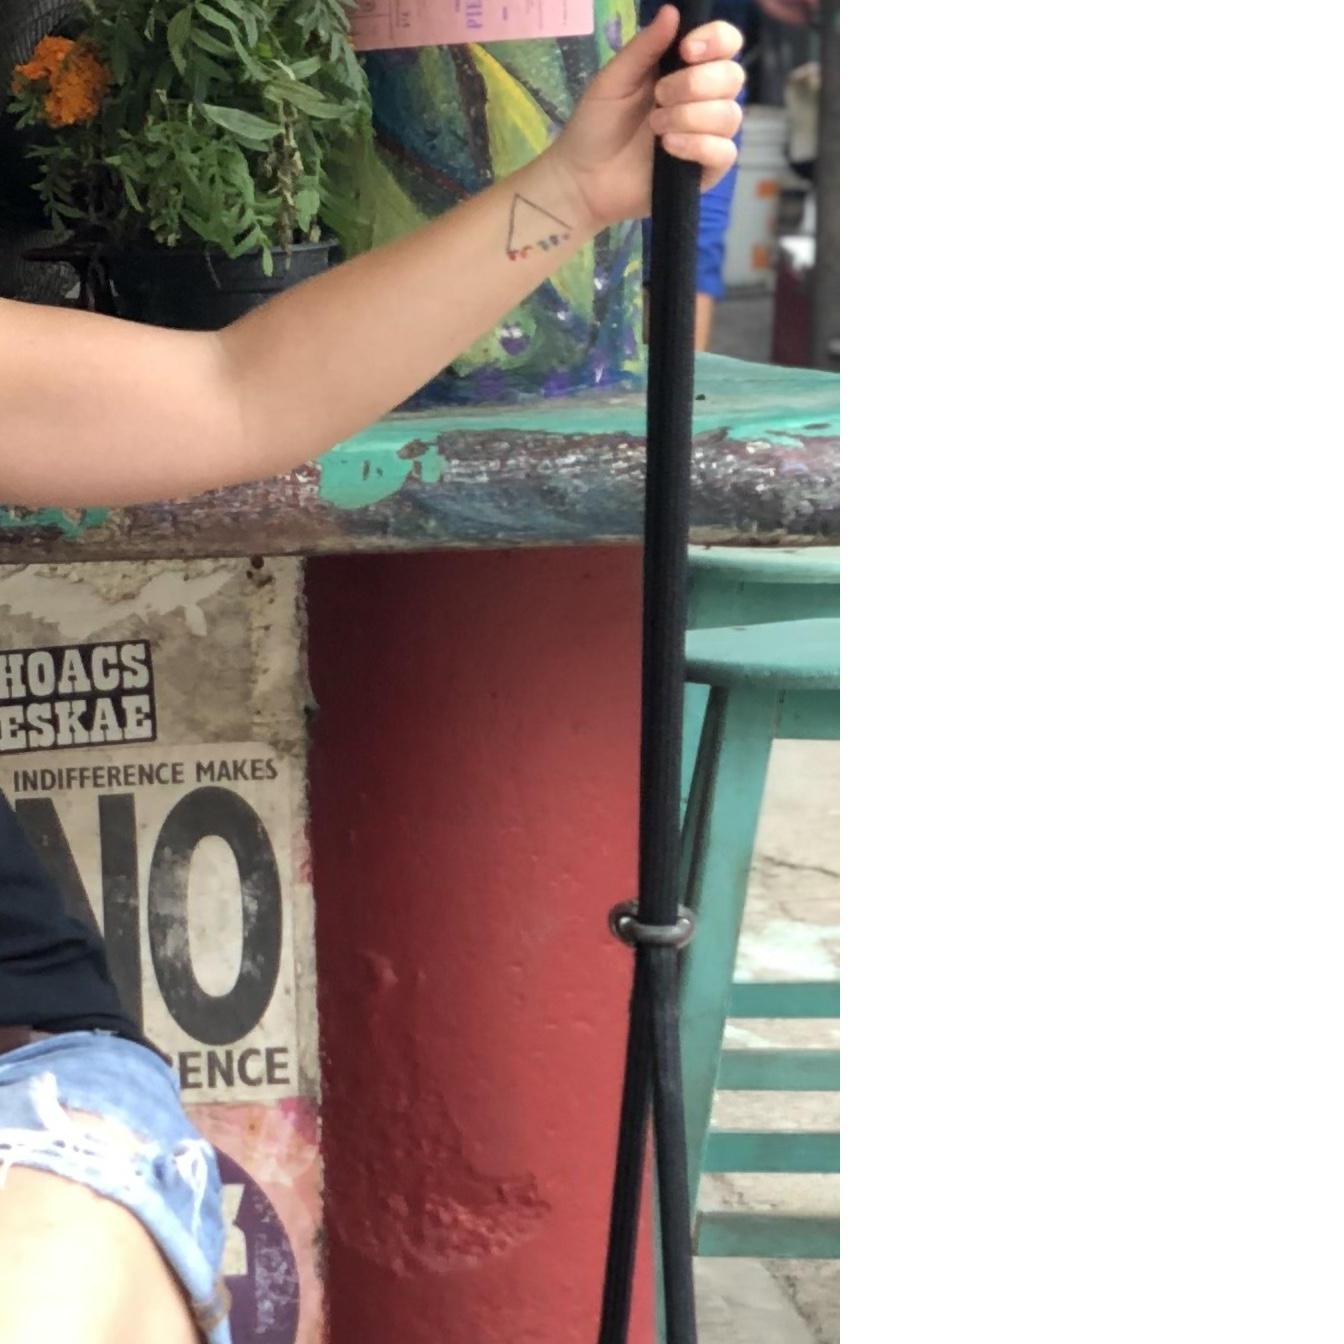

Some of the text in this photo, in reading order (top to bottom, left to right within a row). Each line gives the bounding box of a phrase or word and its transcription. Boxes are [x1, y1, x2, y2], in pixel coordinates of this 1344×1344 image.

[14, 759, 279, 793] INDIFFERENCE MAKES
[162, 1047, 291, 1090] ENCE
